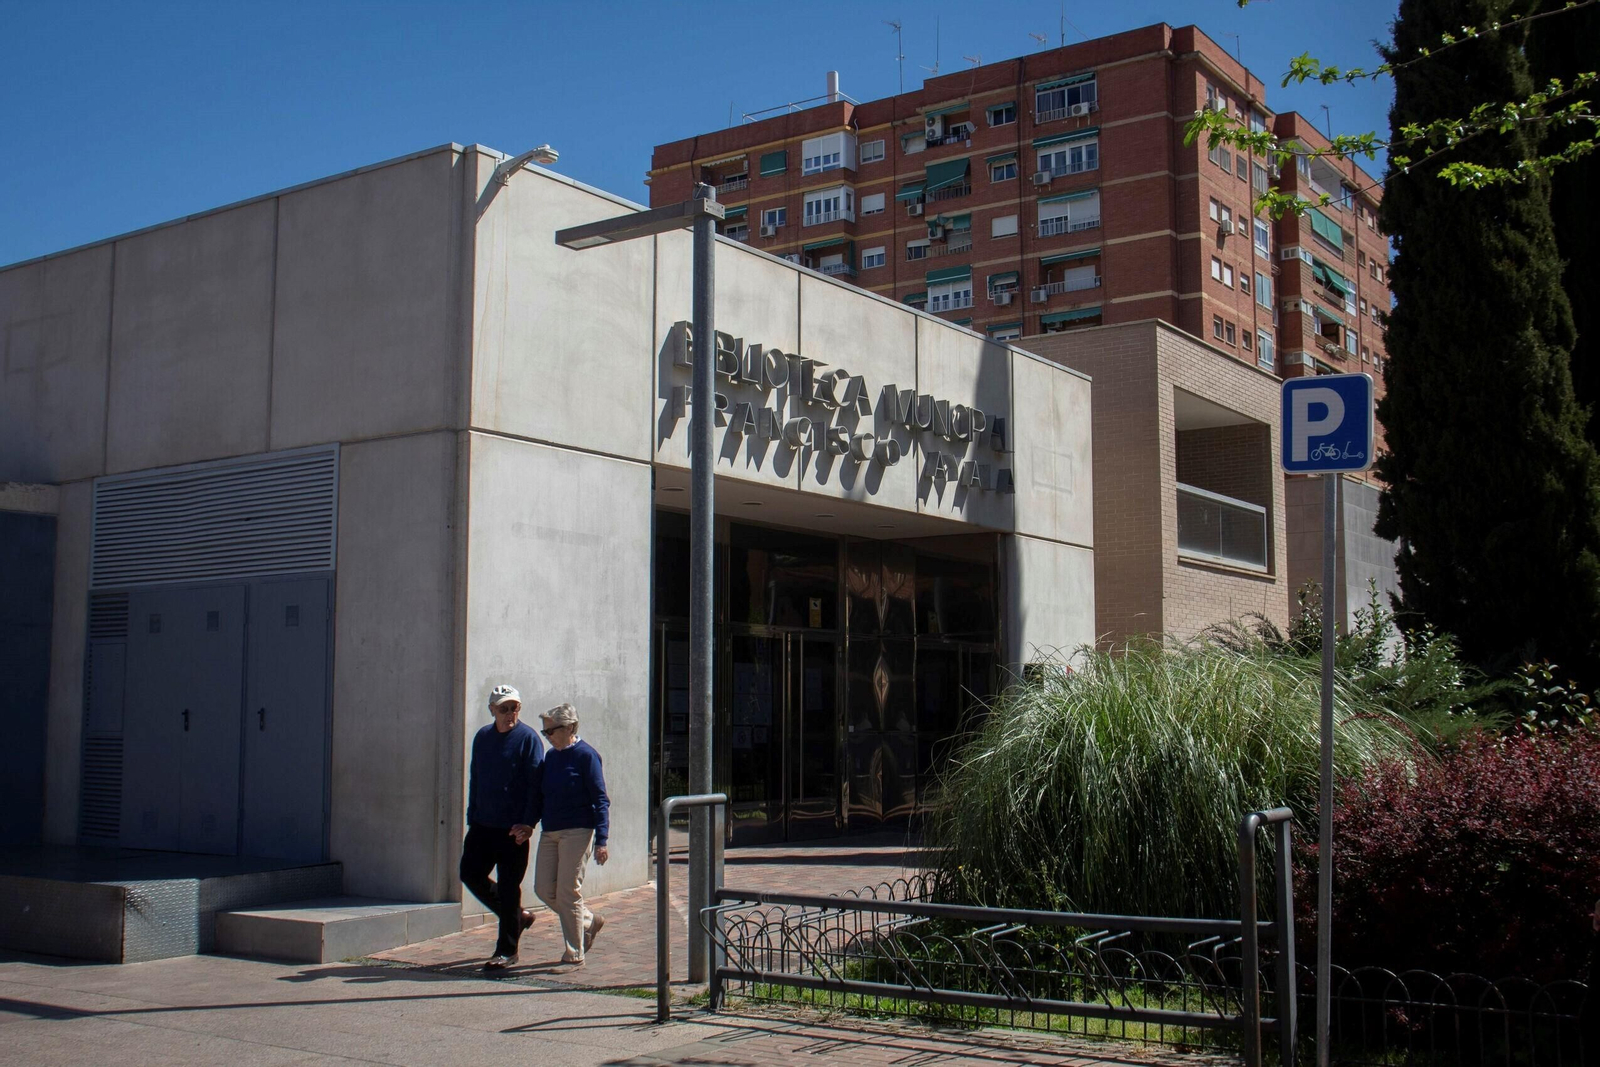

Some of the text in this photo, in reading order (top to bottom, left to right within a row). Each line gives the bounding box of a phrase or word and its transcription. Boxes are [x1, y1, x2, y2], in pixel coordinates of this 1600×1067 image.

[672, 385, 1015, 494] FRANCISCO AYALA
[673, 320, 1015, 453] BBLIOTECA MUNICIPAL
[1292, 387, 1345, 461] P
